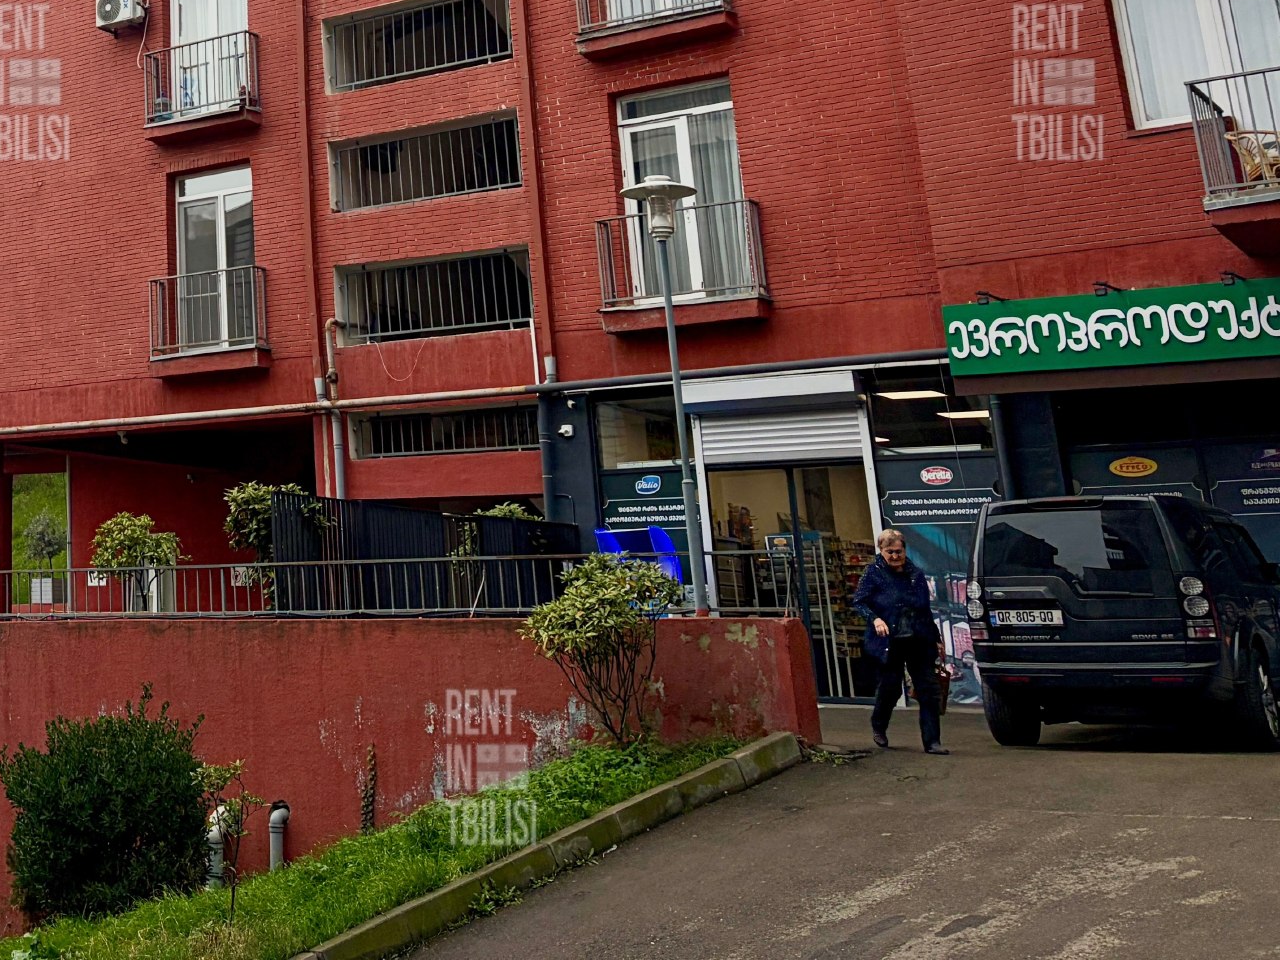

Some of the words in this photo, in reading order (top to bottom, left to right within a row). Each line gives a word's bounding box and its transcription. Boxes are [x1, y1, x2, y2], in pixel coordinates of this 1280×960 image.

[948, 295, 1280, 359] ევროპროდუქტ
[922, 470, 951, 480] Beretta
[997, 611, 1054, 623] QR-805-QQ
